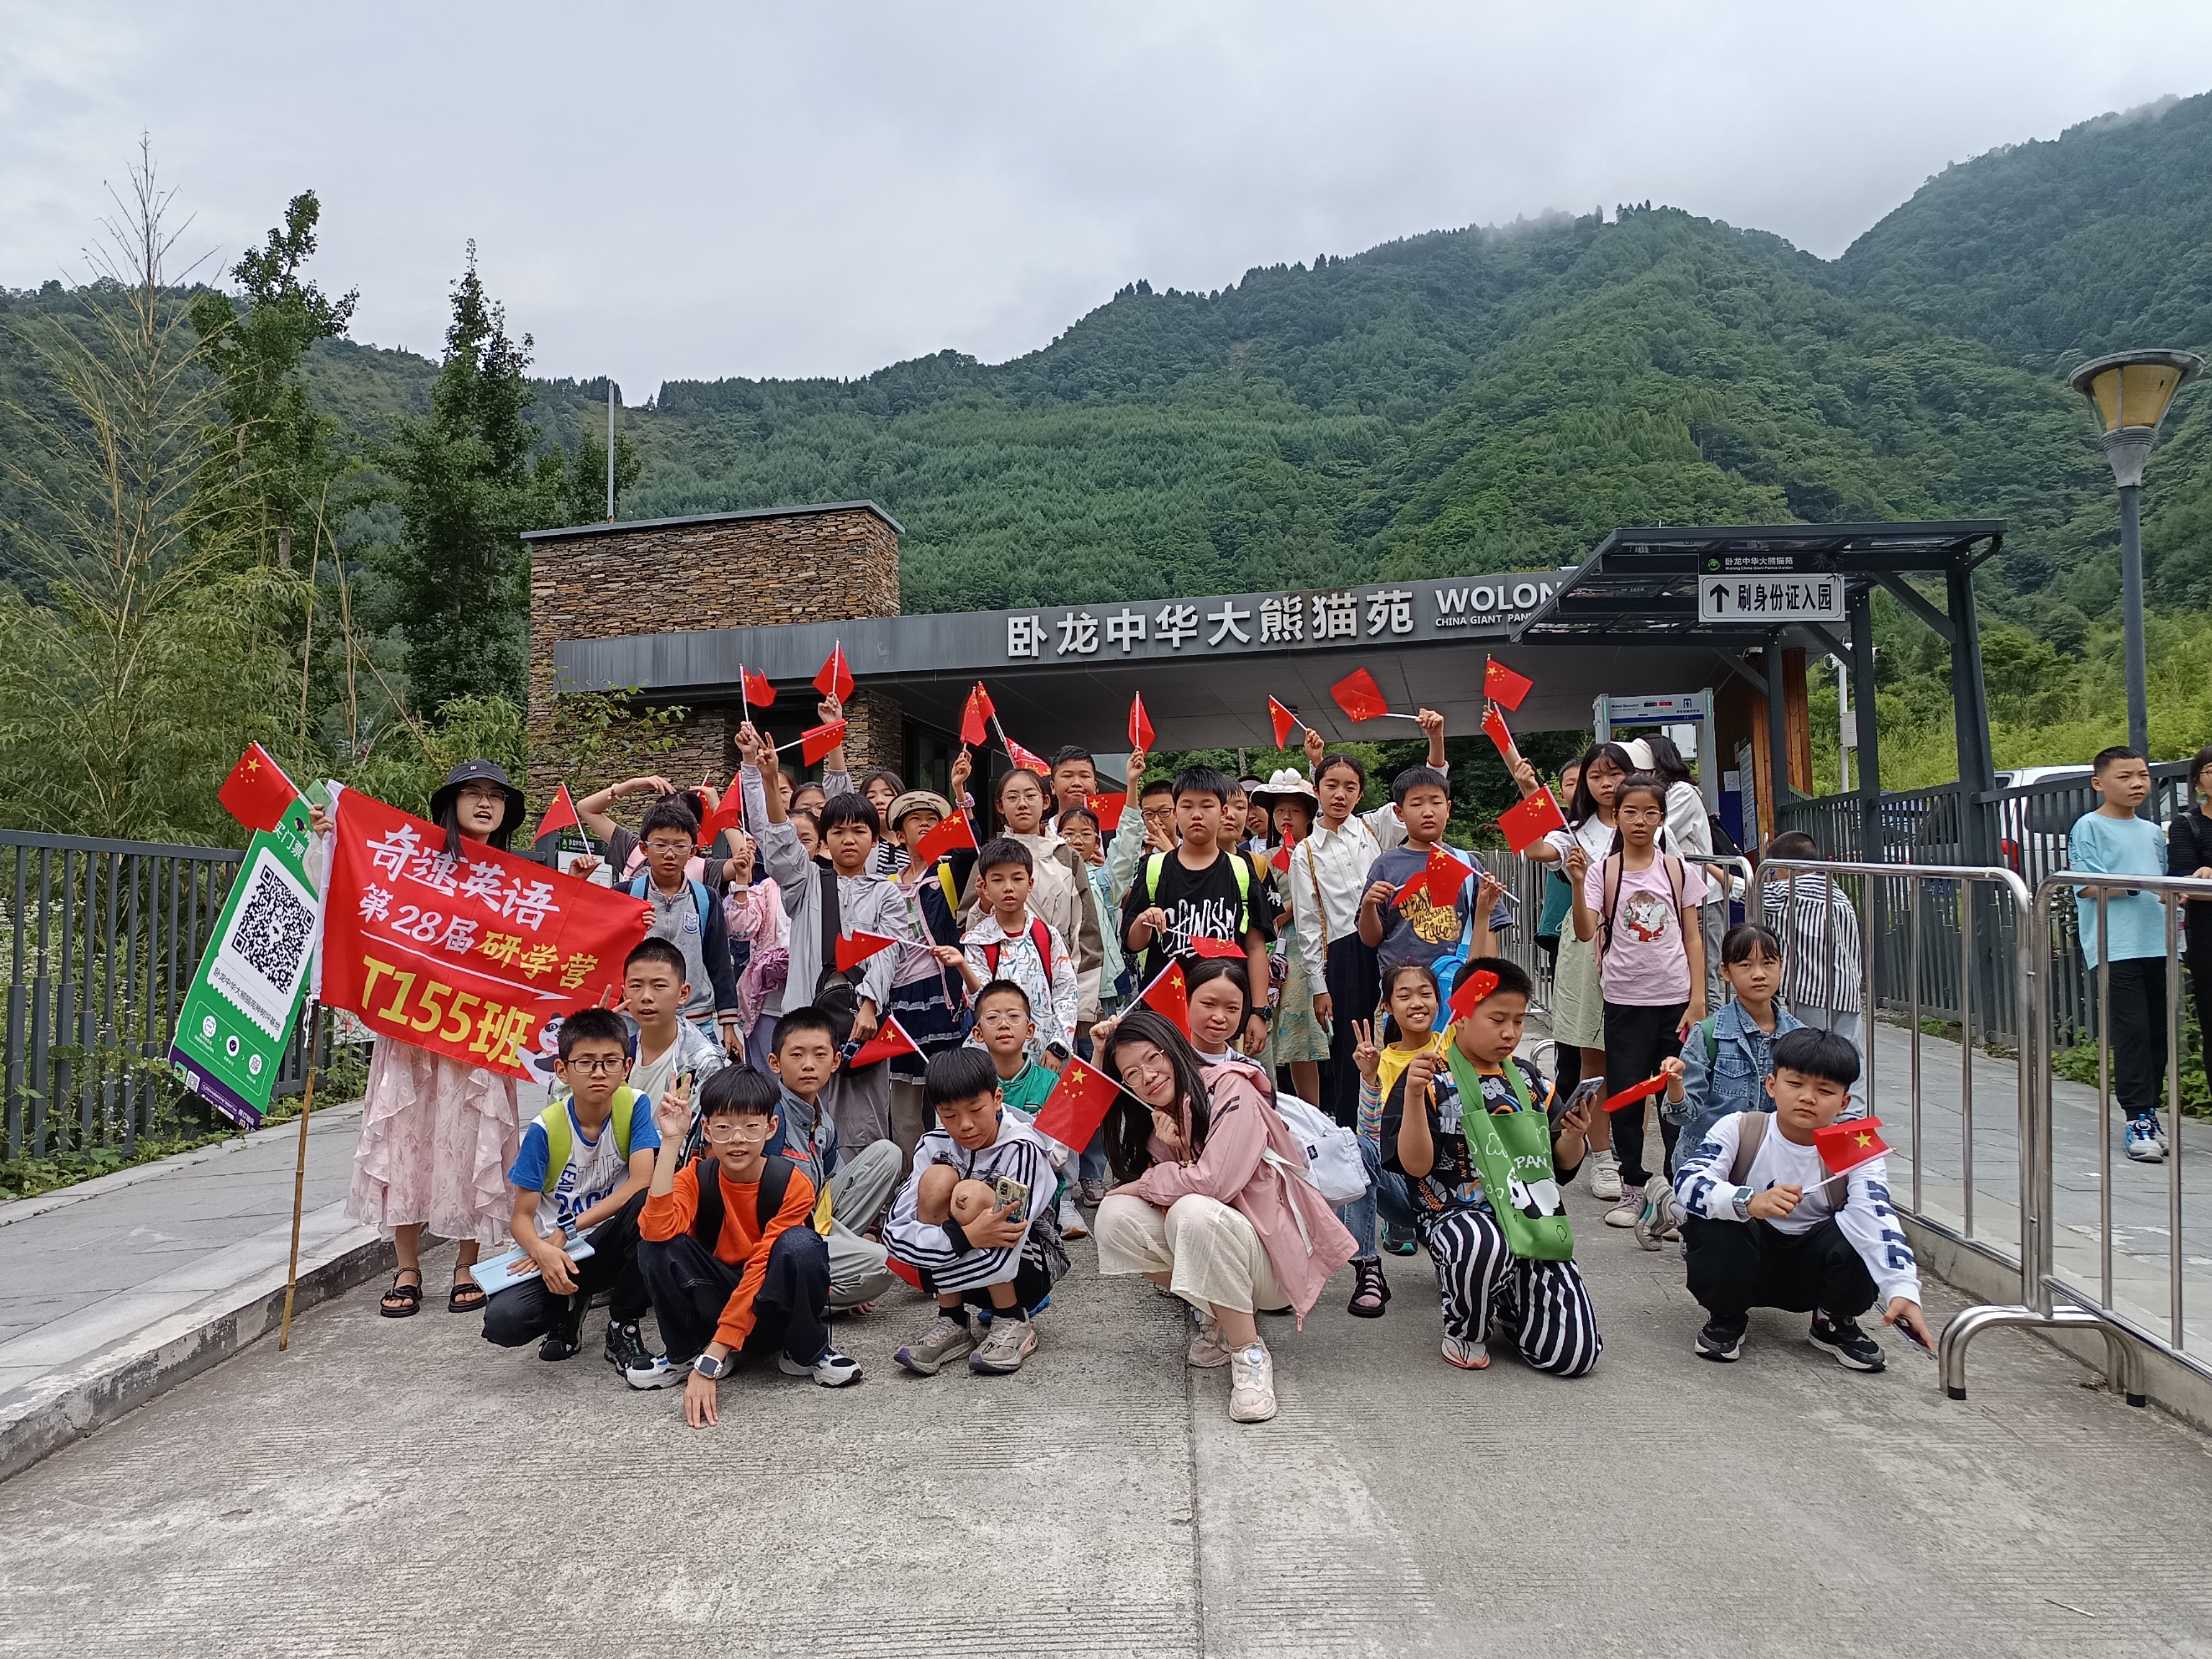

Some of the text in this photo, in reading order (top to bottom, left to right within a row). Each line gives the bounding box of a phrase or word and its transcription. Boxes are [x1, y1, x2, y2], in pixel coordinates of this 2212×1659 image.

[1725, 557, 1793, 566] 卧龙中华大熊猫苑
[1737, 583, 1832, 612] 刷身份证入园
[1008, 589, 1415, 657] 卧龙中华大熊猫苑
[1436, 612, 1532, 627] CHINA GIANT PAN
[367, 823, 560, 931] 奇速英语
[362, 954, 536, 1067] T155班
[1480, 1077, 1506, 1100] 68
[576, 1151, 621, 1194] THE
[1456, 1142, 1468, 1178] JUST PLAY
[557, 1163, 577, 1193] LEAD
